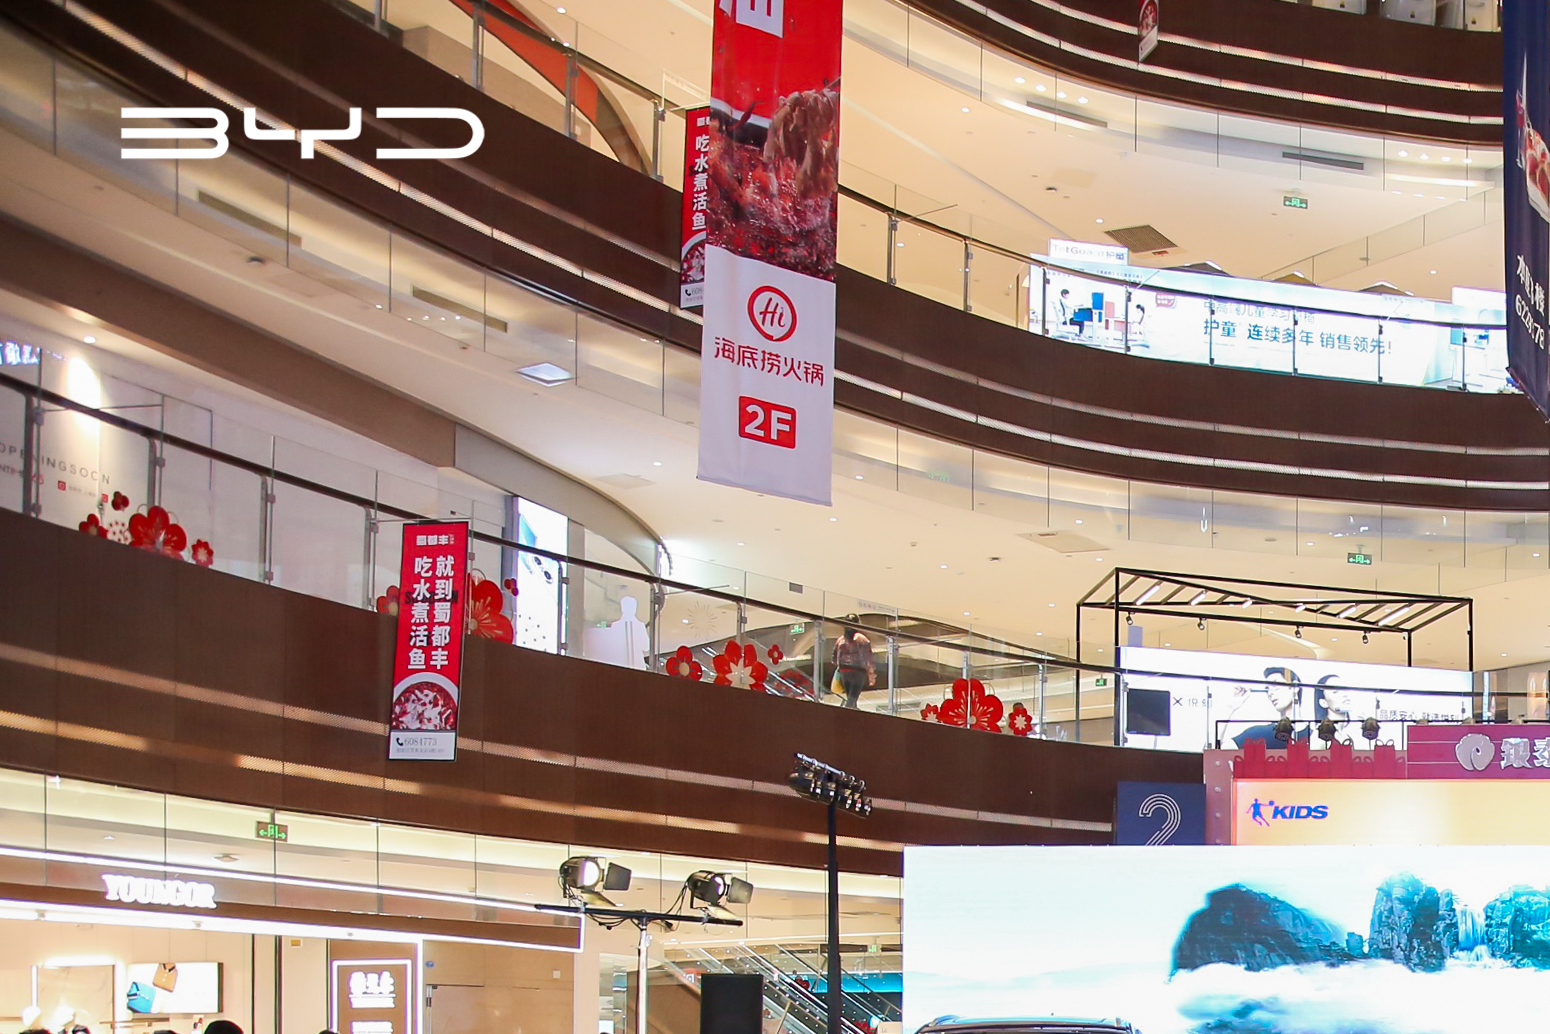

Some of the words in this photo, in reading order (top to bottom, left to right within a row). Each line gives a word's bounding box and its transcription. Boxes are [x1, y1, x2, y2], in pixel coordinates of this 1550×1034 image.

[691, 133, 710, 231] 吃水煮活鱼
[759, 296, 787, 328] Hi
[1203, 317, 1237, 338] 护童
[1247, 323, 1315, 346] 连续多年
[713, 336, 825, 387] 海底捞火锅
[743, 403, 793, 441] 2F
[407, 555, 434, 670] 吃水煮活鱼
[429, 554, 455, 671] 就到蜀都丰
[1271, 804, 1329, 820] KIDS
[102, 873, 218, 909] YOUNGOR
